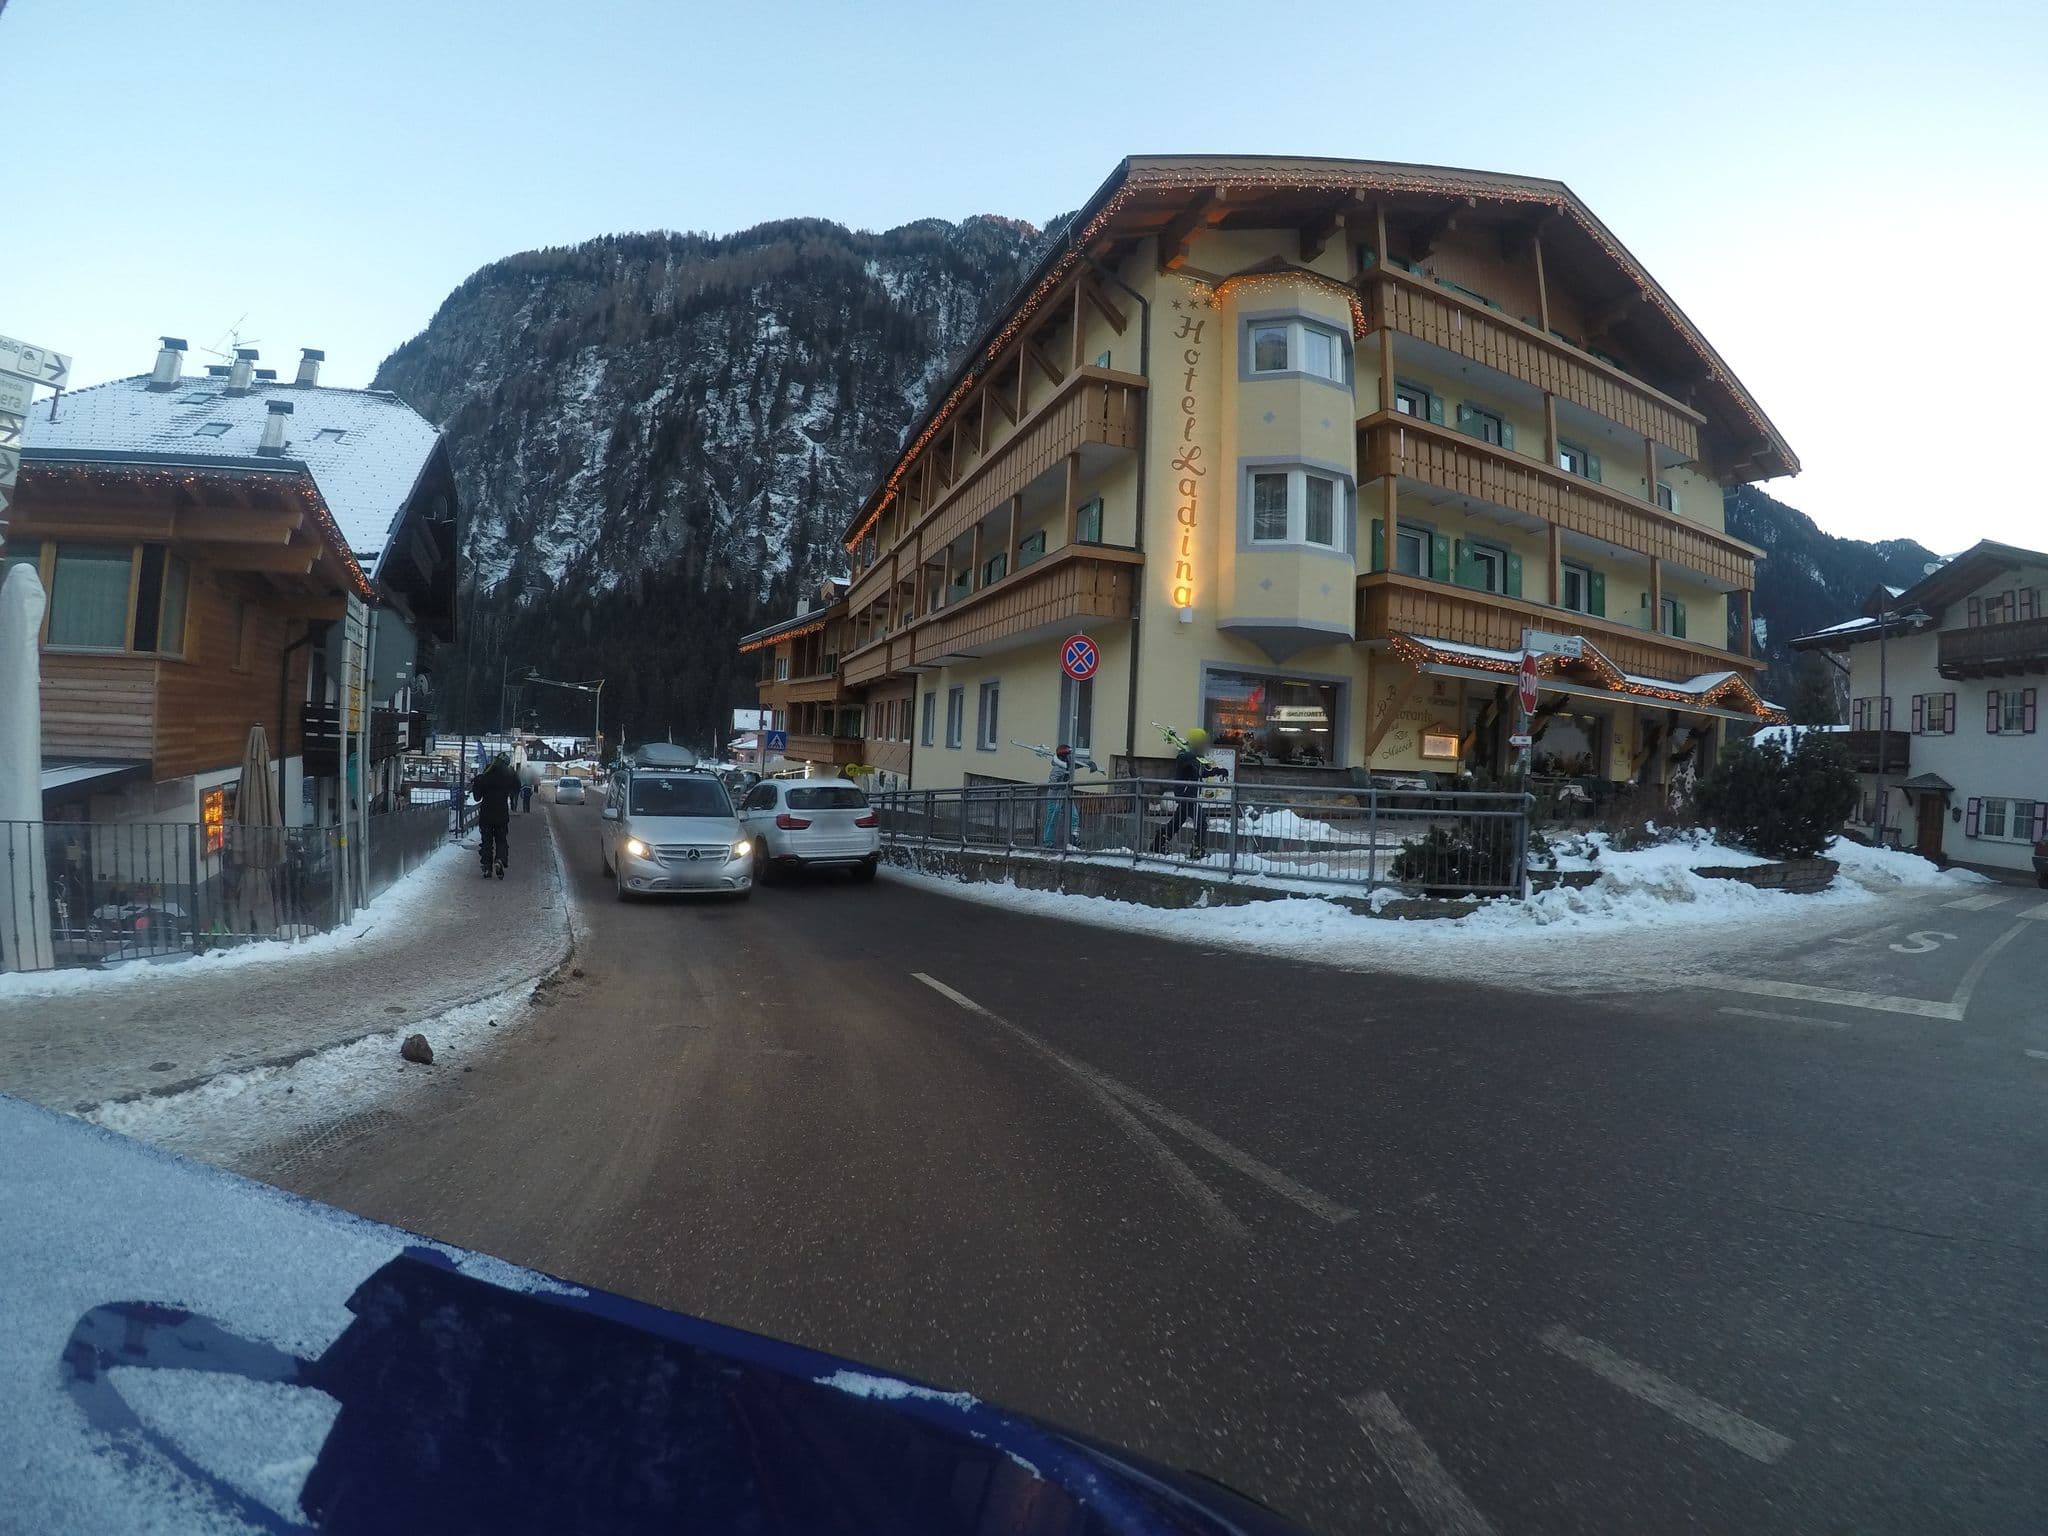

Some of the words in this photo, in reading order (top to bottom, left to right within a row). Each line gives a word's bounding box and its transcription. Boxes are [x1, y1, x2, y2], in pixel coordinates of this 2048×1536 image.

[0, 338, 20, 354] ello
[1173, 315, 1206, 442] Hotel
[1, 394, 22, 409] era
[1171, 445, 1207, 608] Ladina
